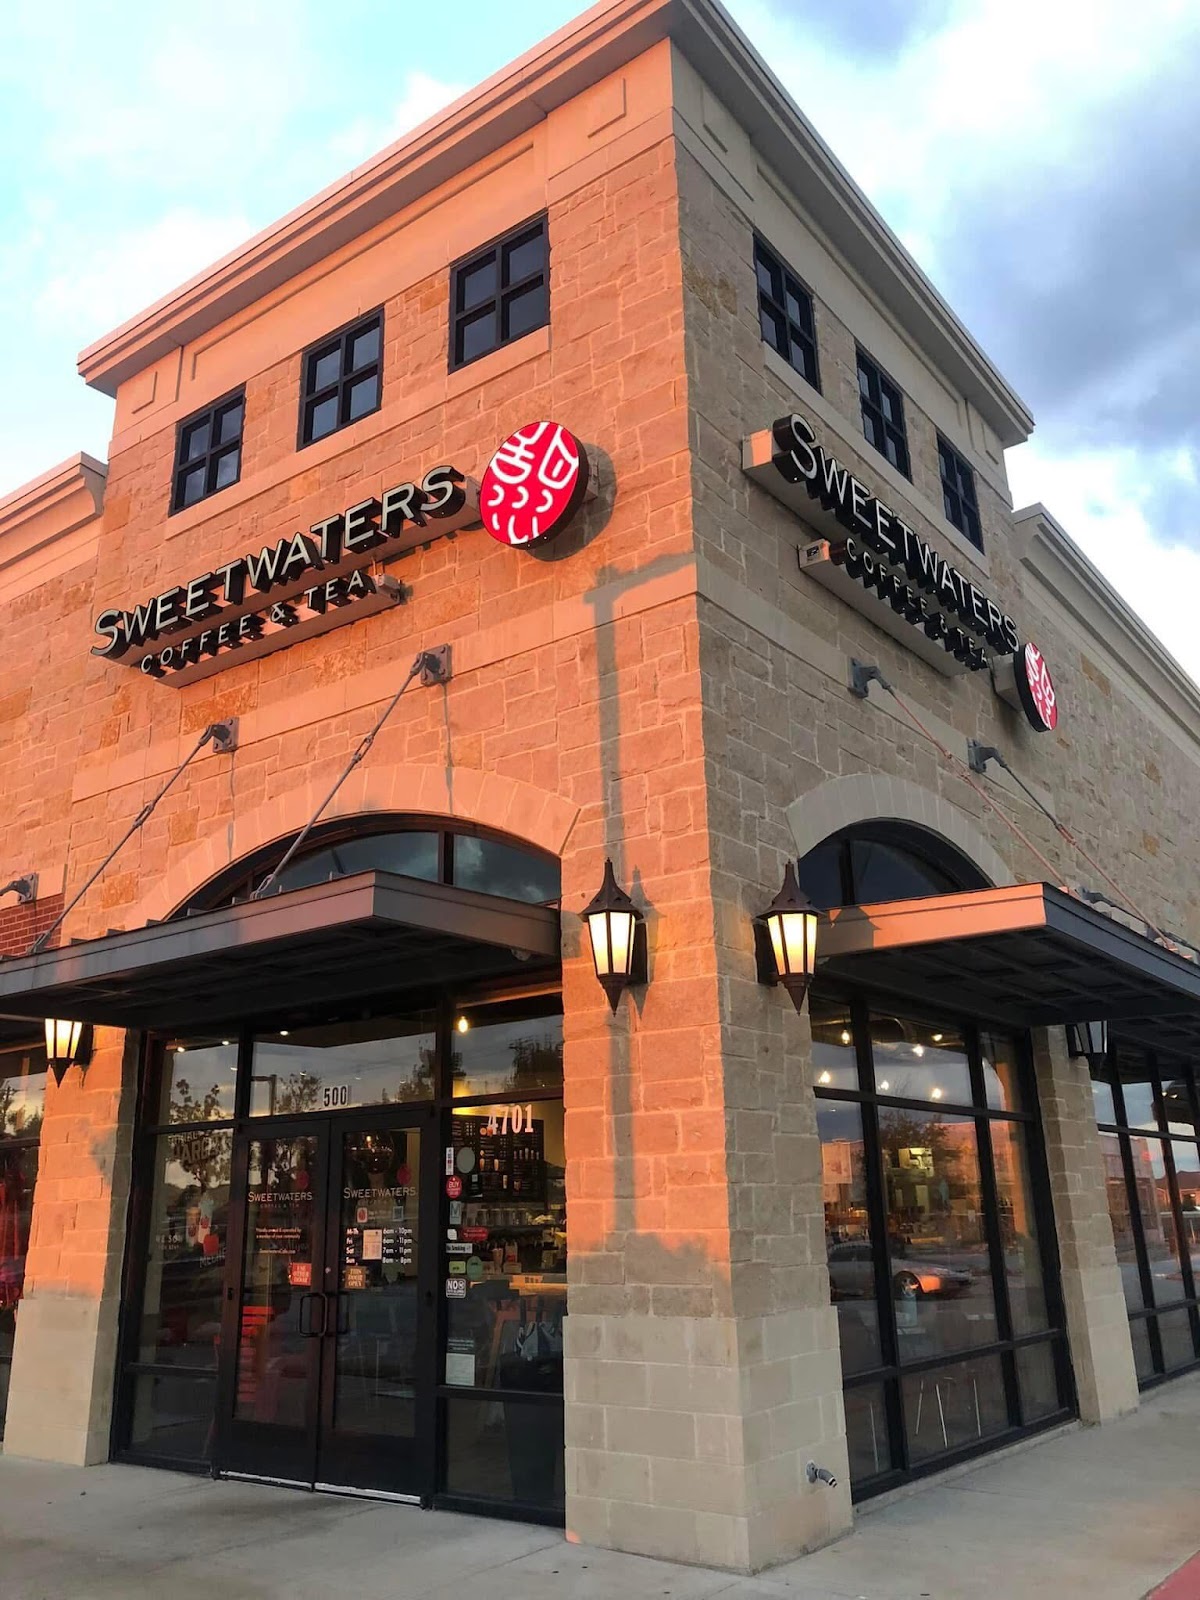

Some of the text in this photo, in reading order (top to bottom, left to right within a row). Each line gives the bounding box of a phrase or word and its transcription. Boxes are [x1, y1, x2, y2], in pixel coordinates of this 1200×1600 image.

[787, 413, 1020, 653] SWEETWATERS
[91, 465, 460, 657] SWEETWATERS
[846, 537, 930, 620] COFFEE
[140, 570, 366, 675] COFFEE & TEA
[323, 1086, 348, 1107] 500
[486, 1104, 534, 1136] 4701
[247, 1191, 313, 1203] SWEETWATERS
[343, 1186, 416, 1199] SWEETWATERS
[447, 1280, 459, 1290] NO
